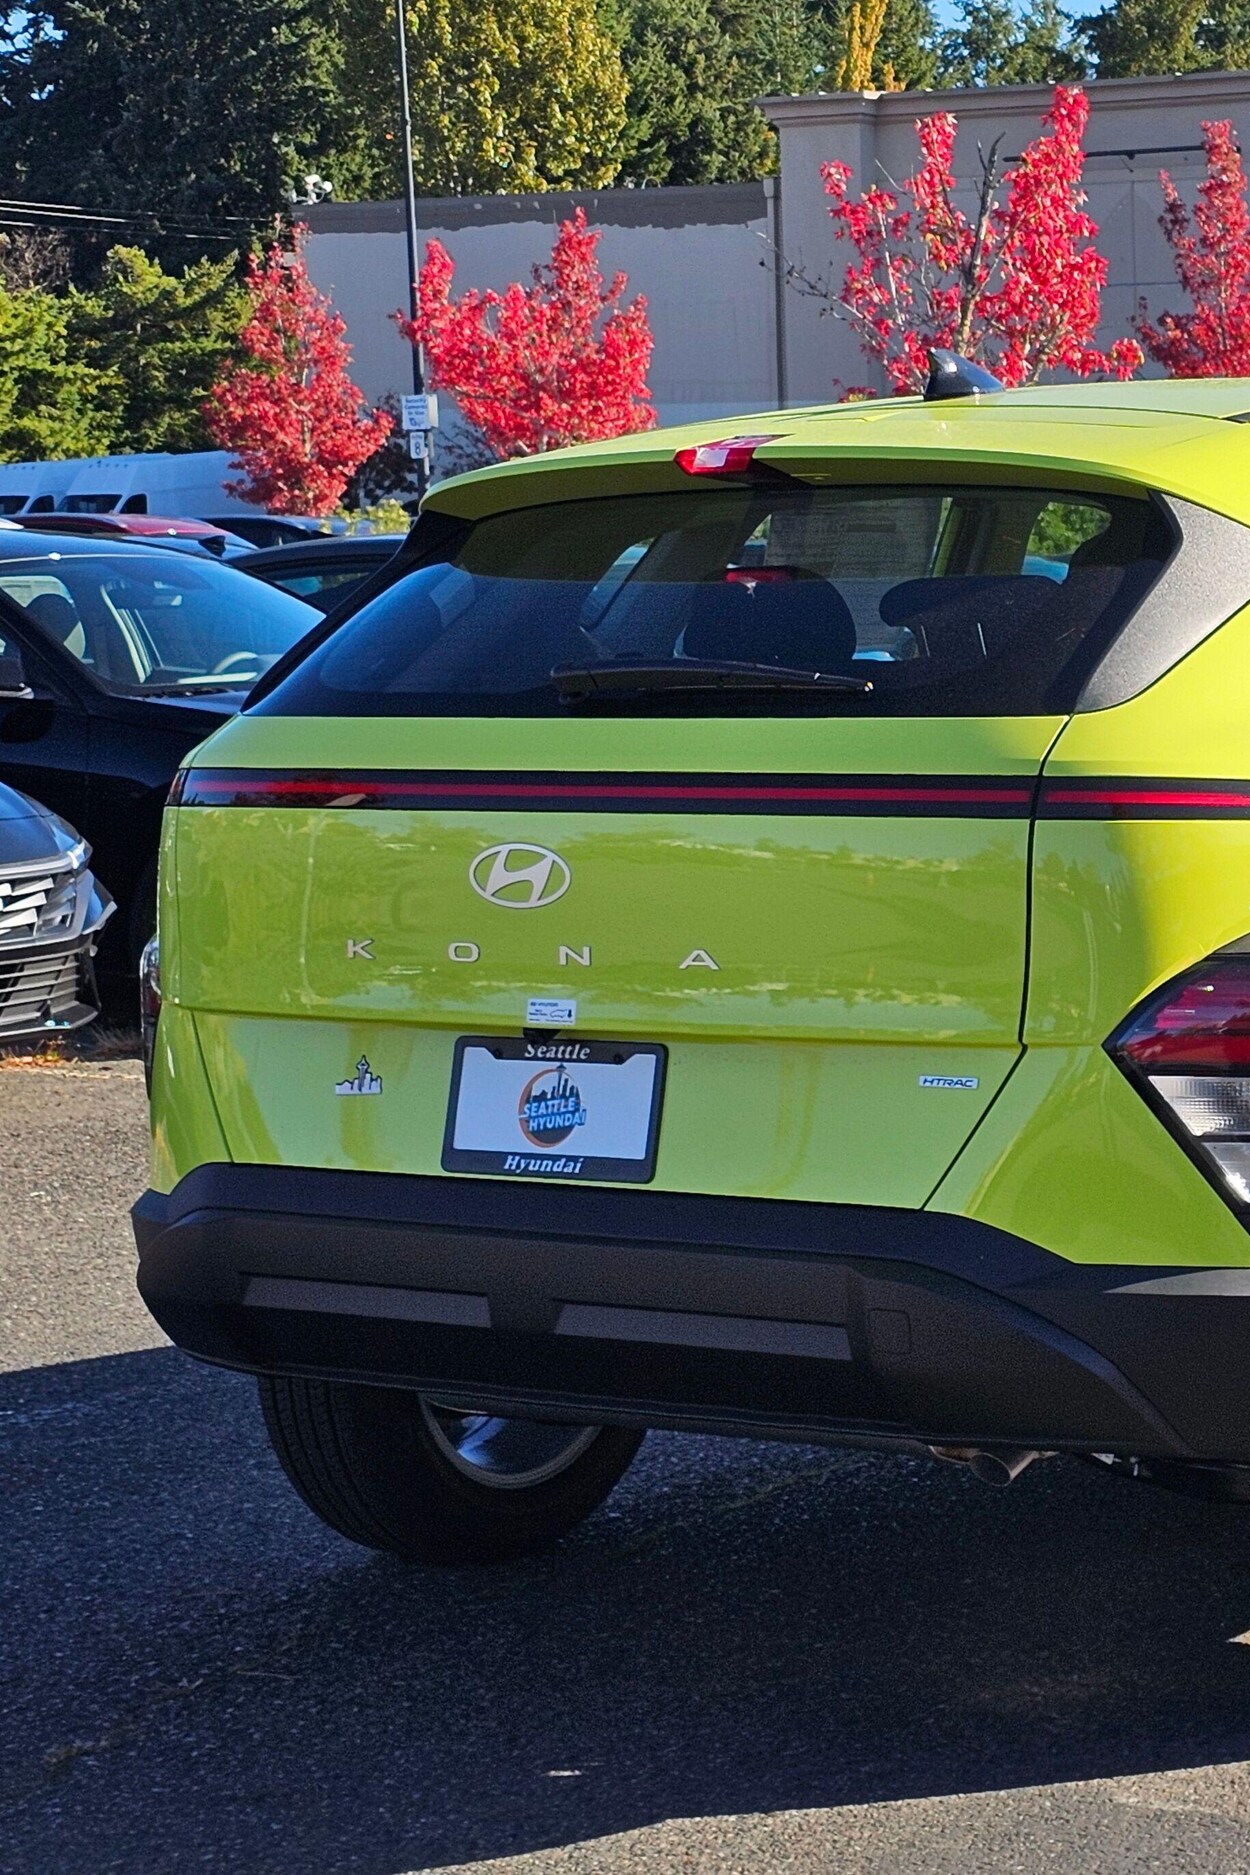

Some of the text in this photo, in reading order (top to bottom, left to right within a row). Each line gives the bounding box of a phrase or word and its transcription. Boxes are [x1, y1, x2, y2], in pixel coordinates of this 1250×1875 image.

[347, 938, 720, 970] KONA
[524, 1043, 591, 1060] Seattle
[923, 1078, 974, 1088] HTRAC
[524, 1097, 577, 1118] SEATTLE
[529, 1109, 587, 1132] HYUNDAI
[503, 1154, 585, 1175] Hyundai
